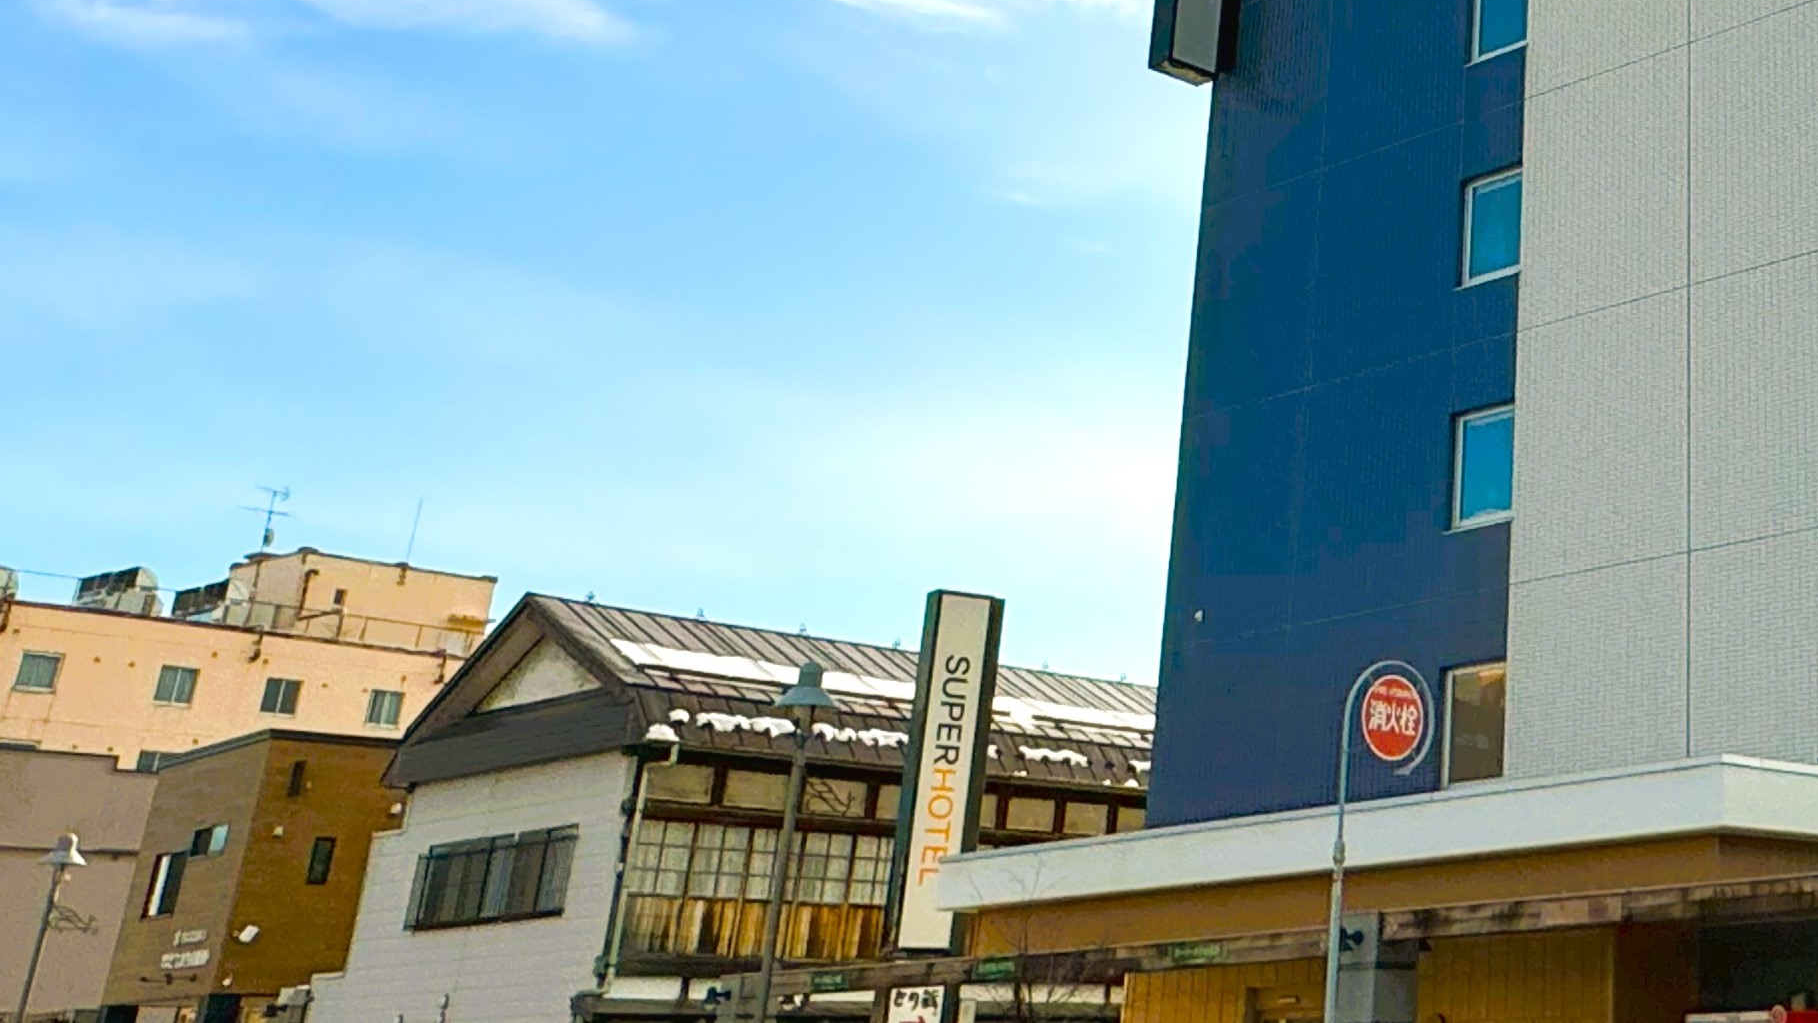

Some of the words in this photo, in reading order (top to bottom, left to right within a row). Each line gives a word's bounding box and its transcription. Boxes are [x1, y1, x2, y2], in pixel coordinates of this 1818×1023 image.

[918, 654, 972, 886] SUPERHOTEL
[1369, 699, 1418, 736] 消火栓
